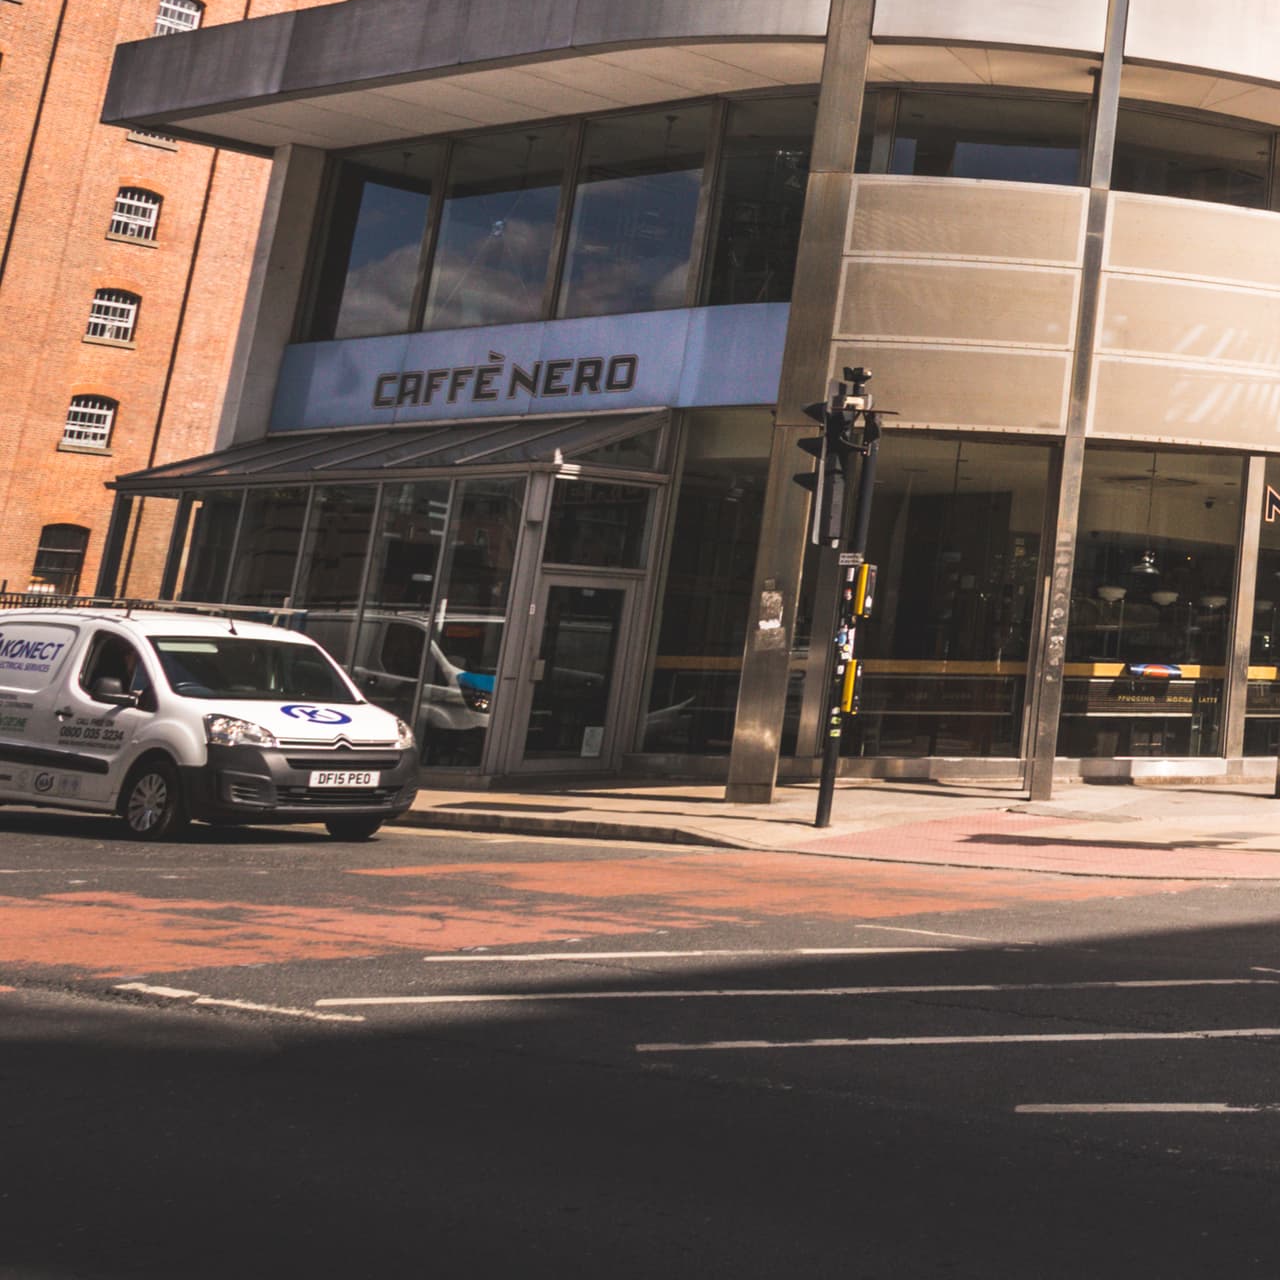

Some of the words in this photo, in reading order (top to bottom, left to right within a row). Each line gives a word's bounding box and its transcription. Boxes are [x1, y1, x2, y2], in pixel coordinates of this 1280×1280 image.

[371, 350, 506, 409] CAFFÈ
[506, 354, 639, 400] NERO
[0, 639, 64, 661] KONECT
[318, 772, 345, 785] DF15
